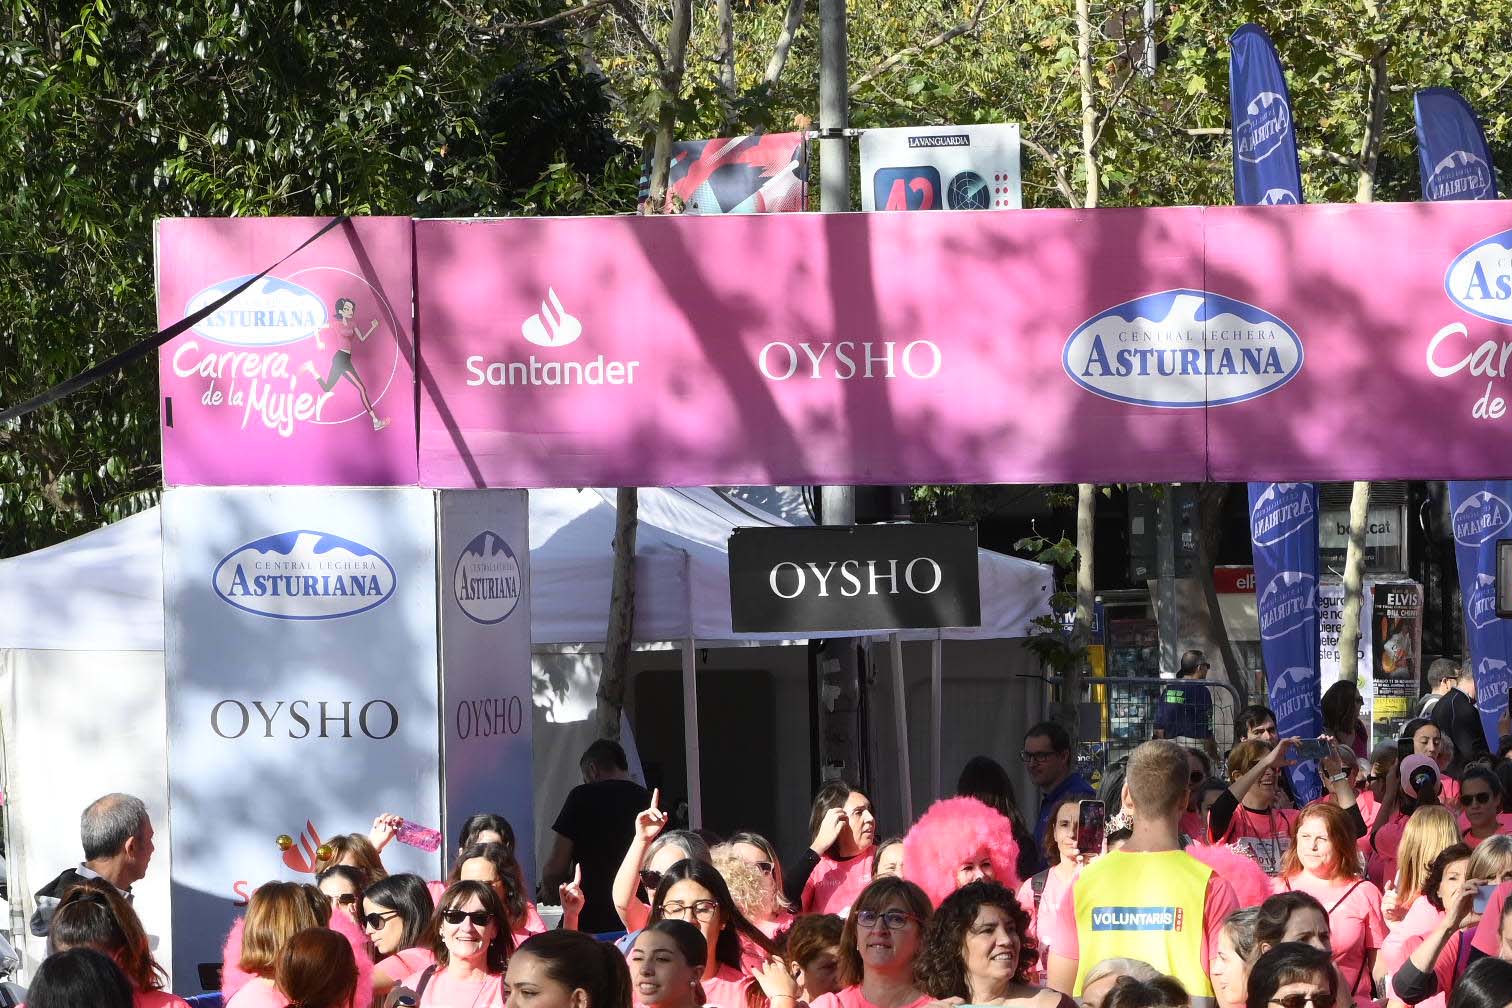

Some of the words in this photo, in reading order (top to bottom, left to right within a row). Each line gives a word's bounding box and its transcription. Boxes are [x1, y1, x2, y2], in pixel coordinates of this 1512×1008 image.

[919, 135, 969, 146] VANGUARDIA
[173, 341, 289, 378] Carrera
[466, 355, 639, 386] Santander
[759, 340, 941, 382] OYSHO
[1081, 335, 1284, 377] ASTURIANA
[202, 380, 223, 405] de
[228, 379, 243, 405] la
[241, 375, 335, 438] Mujer
[1471, 383, 1507, 418] de
[228, 564, 383, 597] ASTURIANA
[256, 561, 312, 571] CENTRAL
[318, 560, 377, 570] LECHERA
[459, 565, 517, 601] ASTURIANA
[769, 556, 942, 598] OYSHO
[1387, 593, 1418, 606] ELVIS
[210, 699, 399, 740] OYSHO
[456, 695, 522, 740] OYSHO
[1093, 912, 1173, 925] VOLUNTARIS
